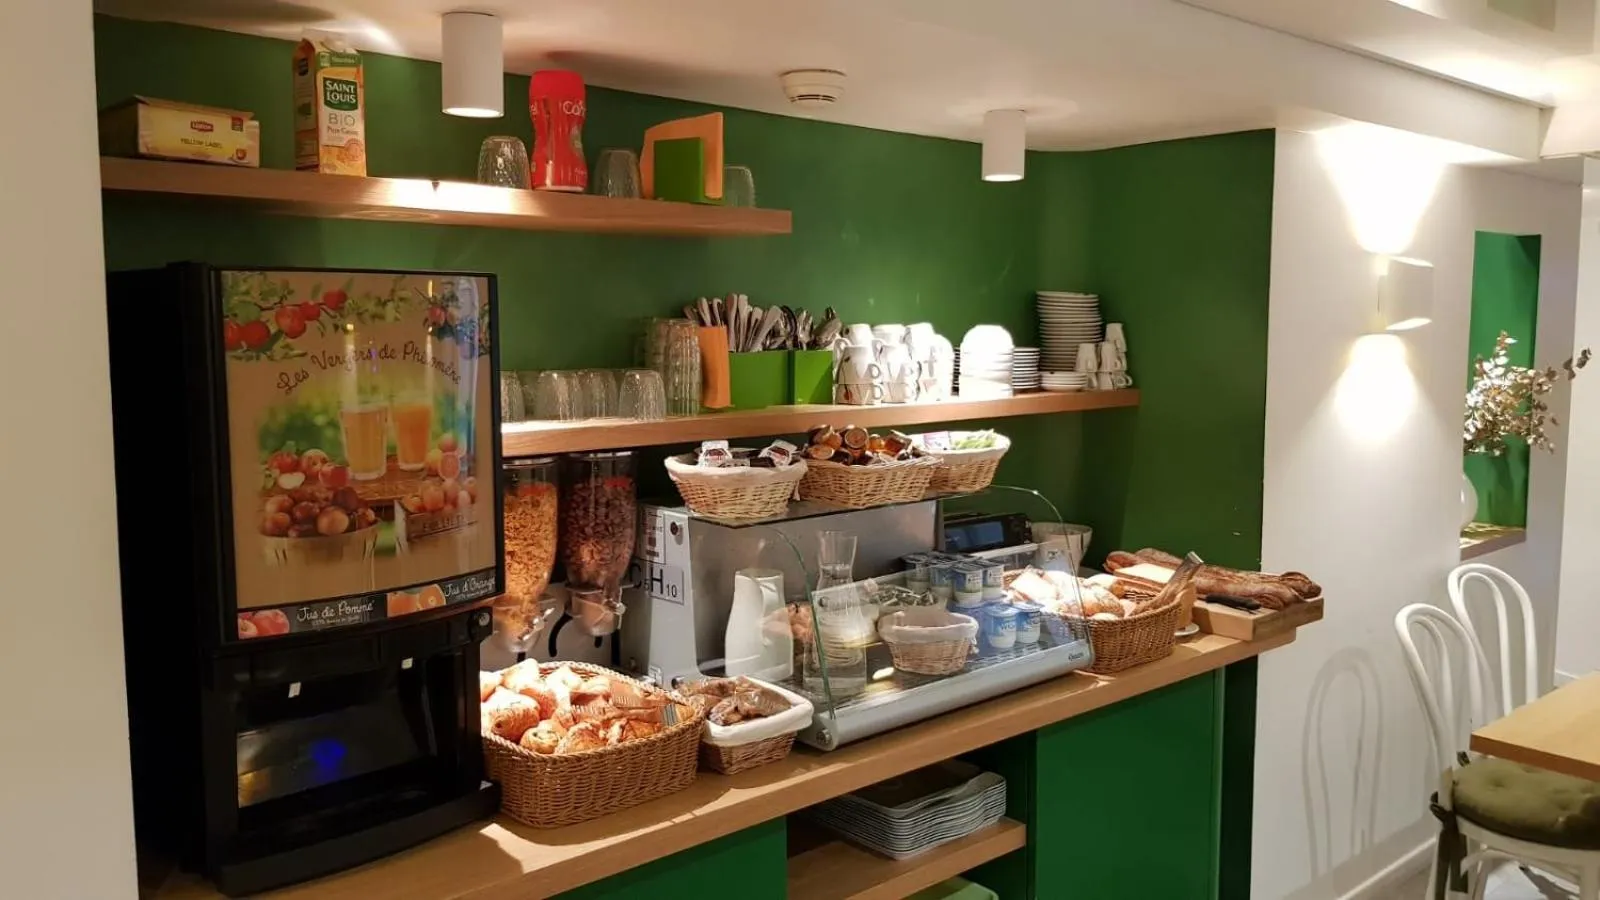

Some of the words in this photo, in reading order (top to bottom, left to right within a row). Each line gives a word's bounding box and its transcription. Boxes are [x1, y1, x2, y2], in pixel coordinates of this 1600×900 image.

[325, 80, 356, 94] SAINT
[326, 90, 356, 104] LOUIS
[204, 141, 223, 149] LABEL
[276, 371, 309, 395] Les
[378, 344, 397, 360] de
[444, 583, 460, 597] Jus
[296, 606, 319, 622] Jus
[321, 605, 336, 619] de
